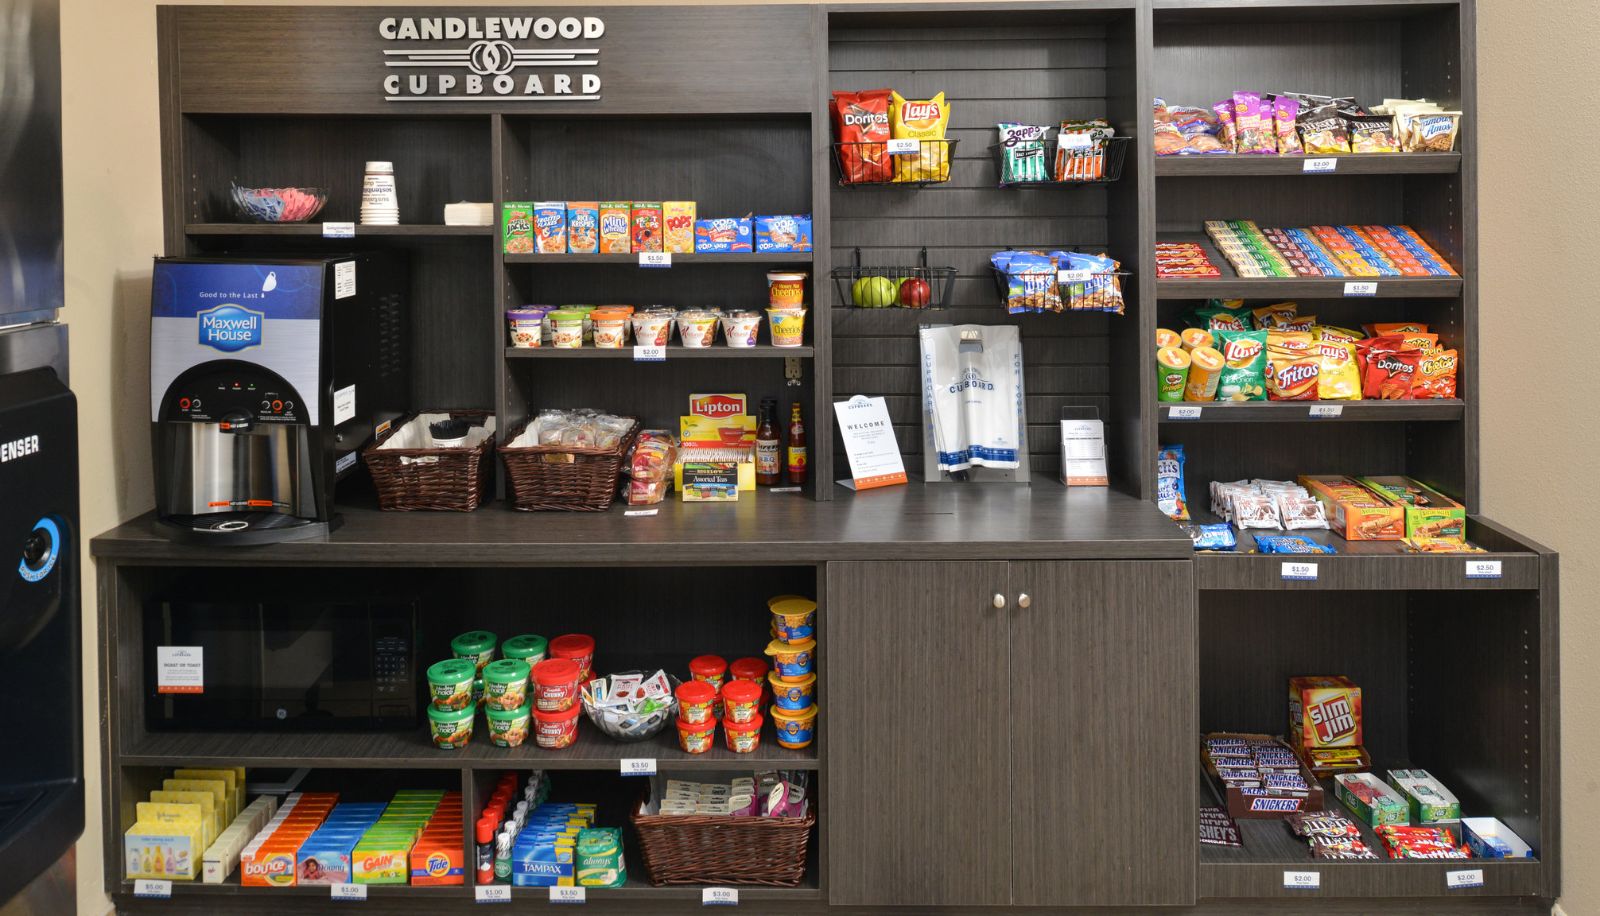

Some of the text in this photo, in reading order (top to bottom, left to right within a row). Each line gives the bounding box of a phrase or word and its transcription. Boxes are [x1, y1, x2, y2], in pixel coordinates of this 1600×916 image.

[379, 17, 605, 40] CANDLEWOOD
[383, 74, 602, 95] CUPBOARD
[845, 113, 889, 126] Doritos
[771, 286, 802, 297] Cheerios
[202, 316, 257, 330] Maxwell
[774, 325, 802, 334] Cheerios
[208, 328, 252, 341] House
[1377, 359, 1414, 373] Doritos
[1422, 356, 1455, 375] Cheetos
[1277, 363, 1319, 390] Fritos
[696, 401, 740, 415] Lipton
[847, 420, 885, 430] WELCOME
[0, 434, 39, 463] ENSER
[1213, 745, 1251, 754] SNICKERS
[631, 761, 649, 769] $3.50
[1217, 758, 1255, 766] SNICKERS
[1220, 769, 1258, 778] SNICKERS
[1264, 774, 1304, 782] SNICKERS
[1268, 780, 1308, 788] SNICKERS
[1253, 798, 1299, 811] SNICKERS
[363, 855, 393, 871] GAIN
[427, 857, 449, 873] Tide
[583, 856, 613, 866] always
[244, 861, 286, 876] bounce
[317, 863, 346, 873] Downy
[522, 863, 562, 874] TAMPAX
[1457, 873, 1476, 881] $2.00
